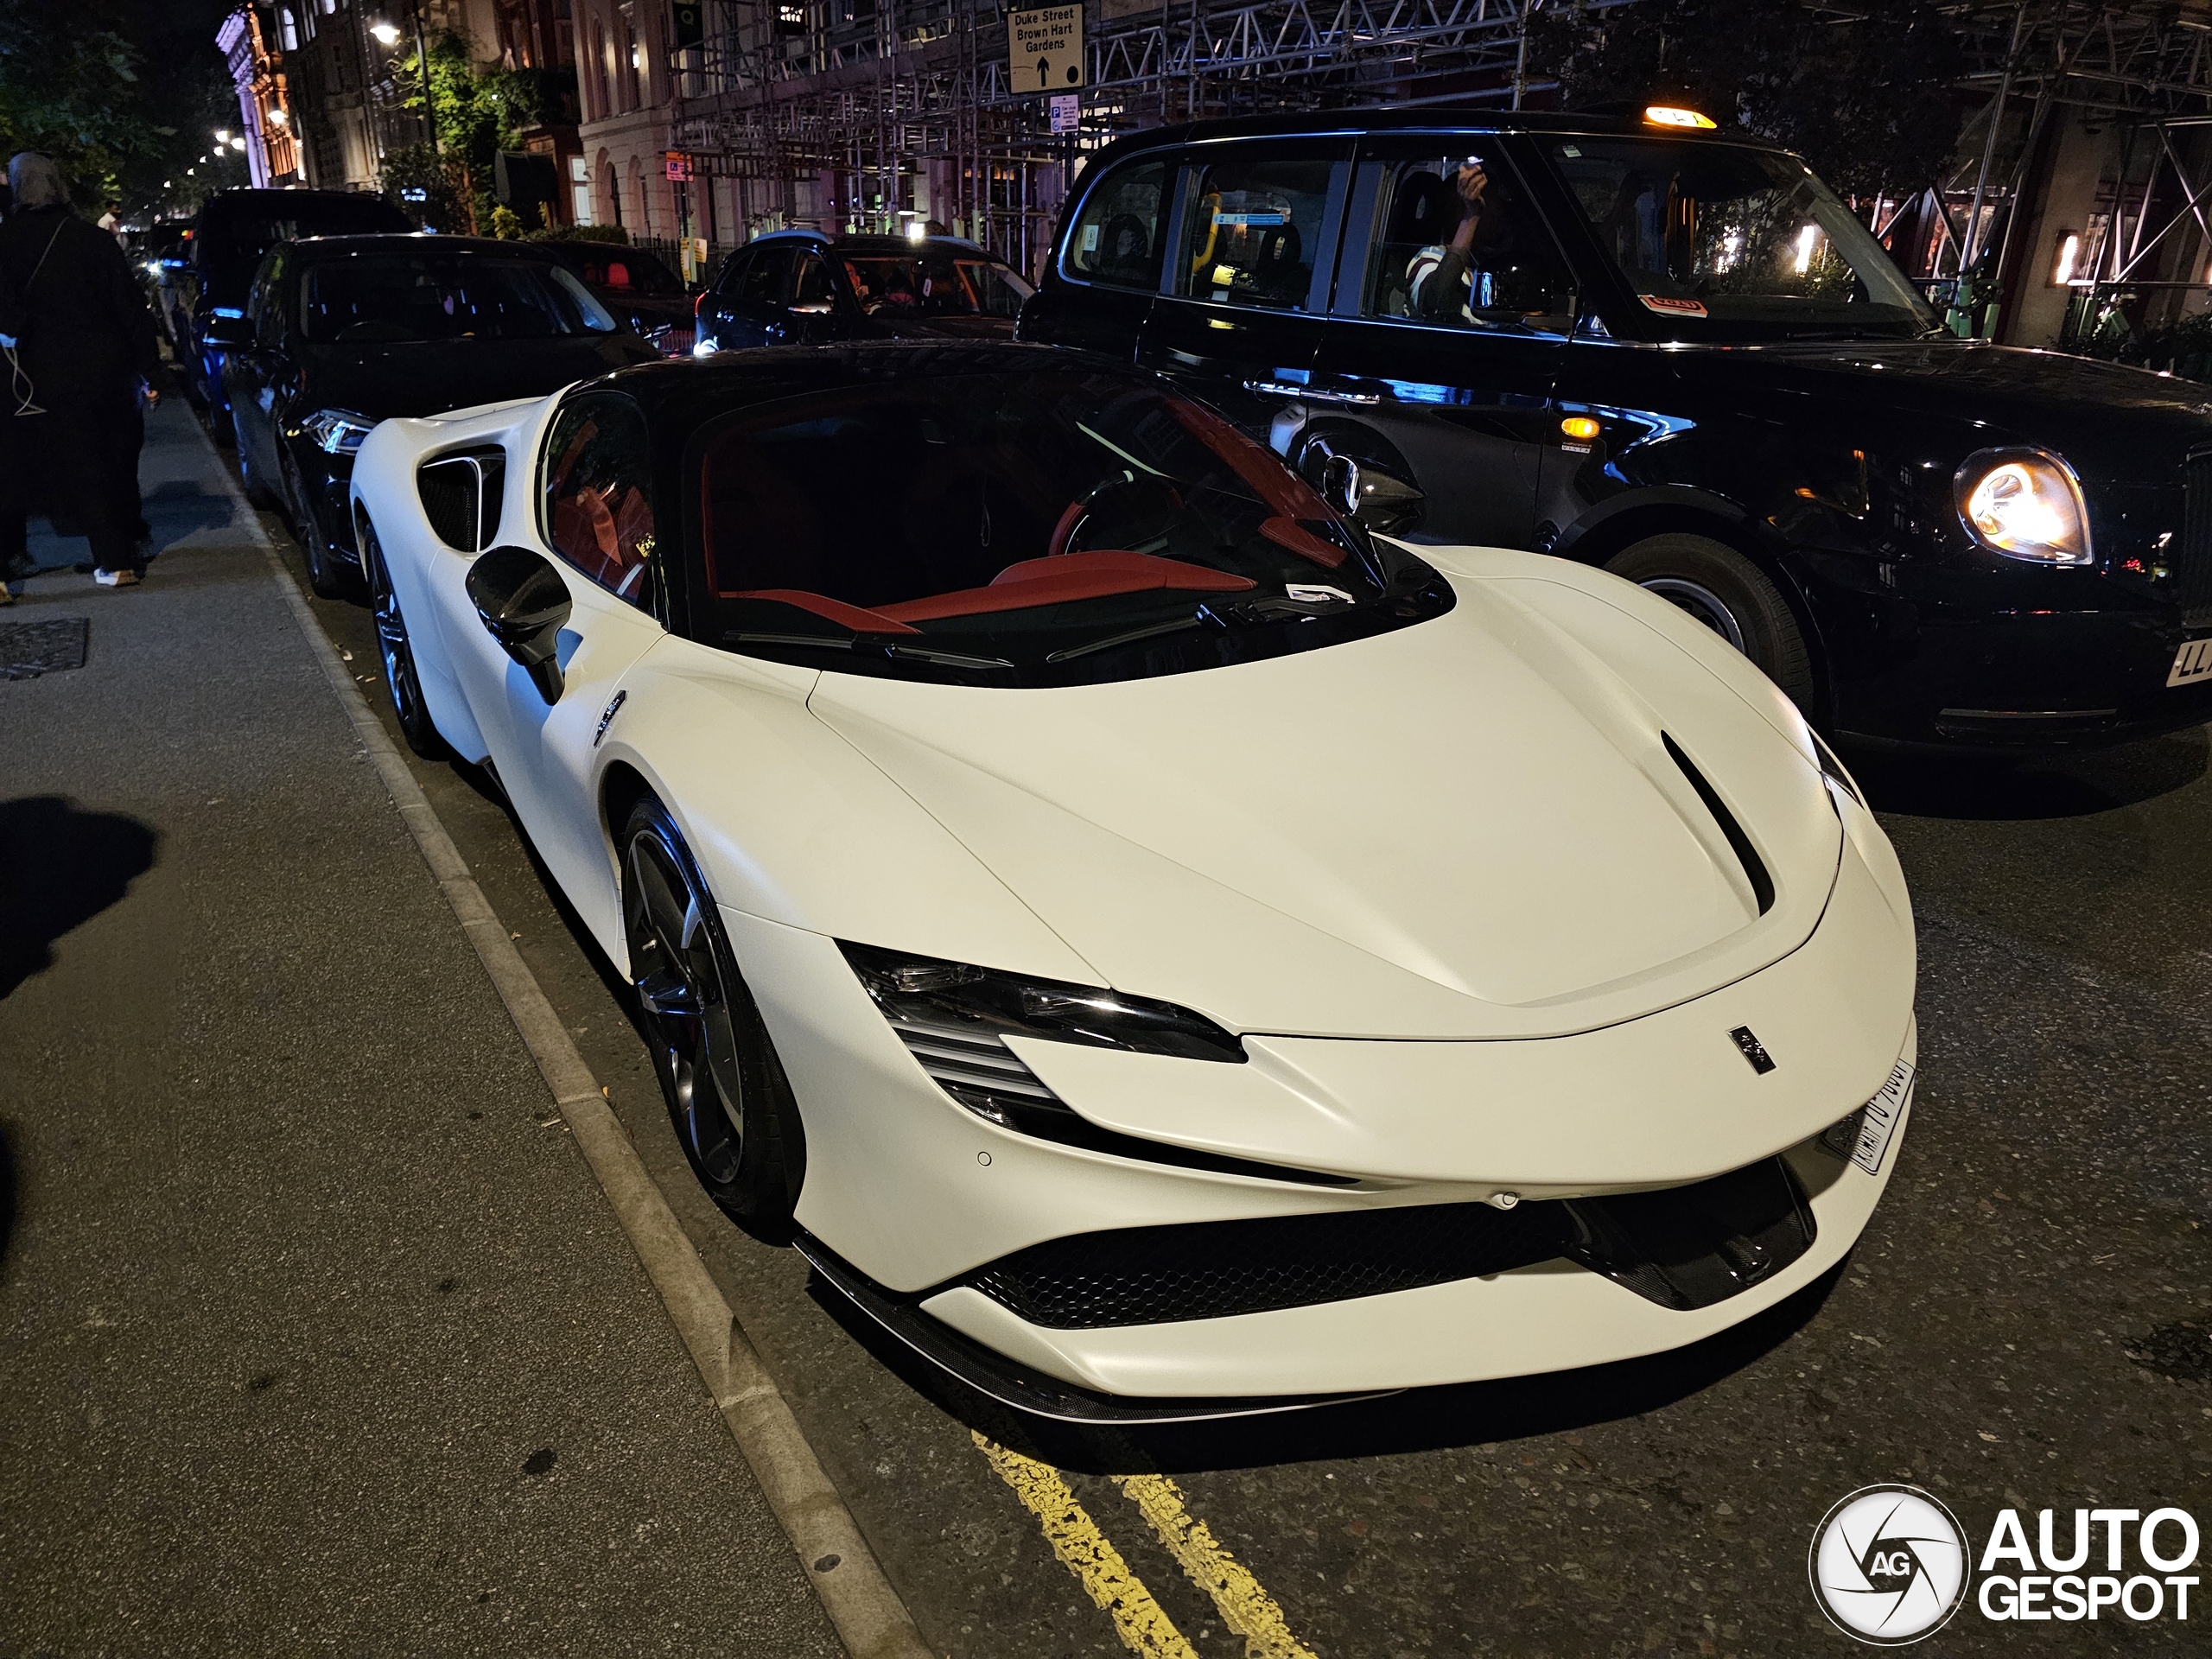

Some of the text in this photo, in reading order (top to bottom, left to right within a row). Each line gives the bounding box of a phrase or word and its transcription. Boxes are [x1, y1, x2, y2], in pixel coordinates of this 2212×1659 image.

[1015, 7, 1074, 26] Duke Street
[1017, 22, 1073, 41] Brown Hart
[1026, 39, 1065, 53] Gardens
[1052, 108, 1059, 118] P
[1851, 1125, 1881, 1165] KUWAIT
